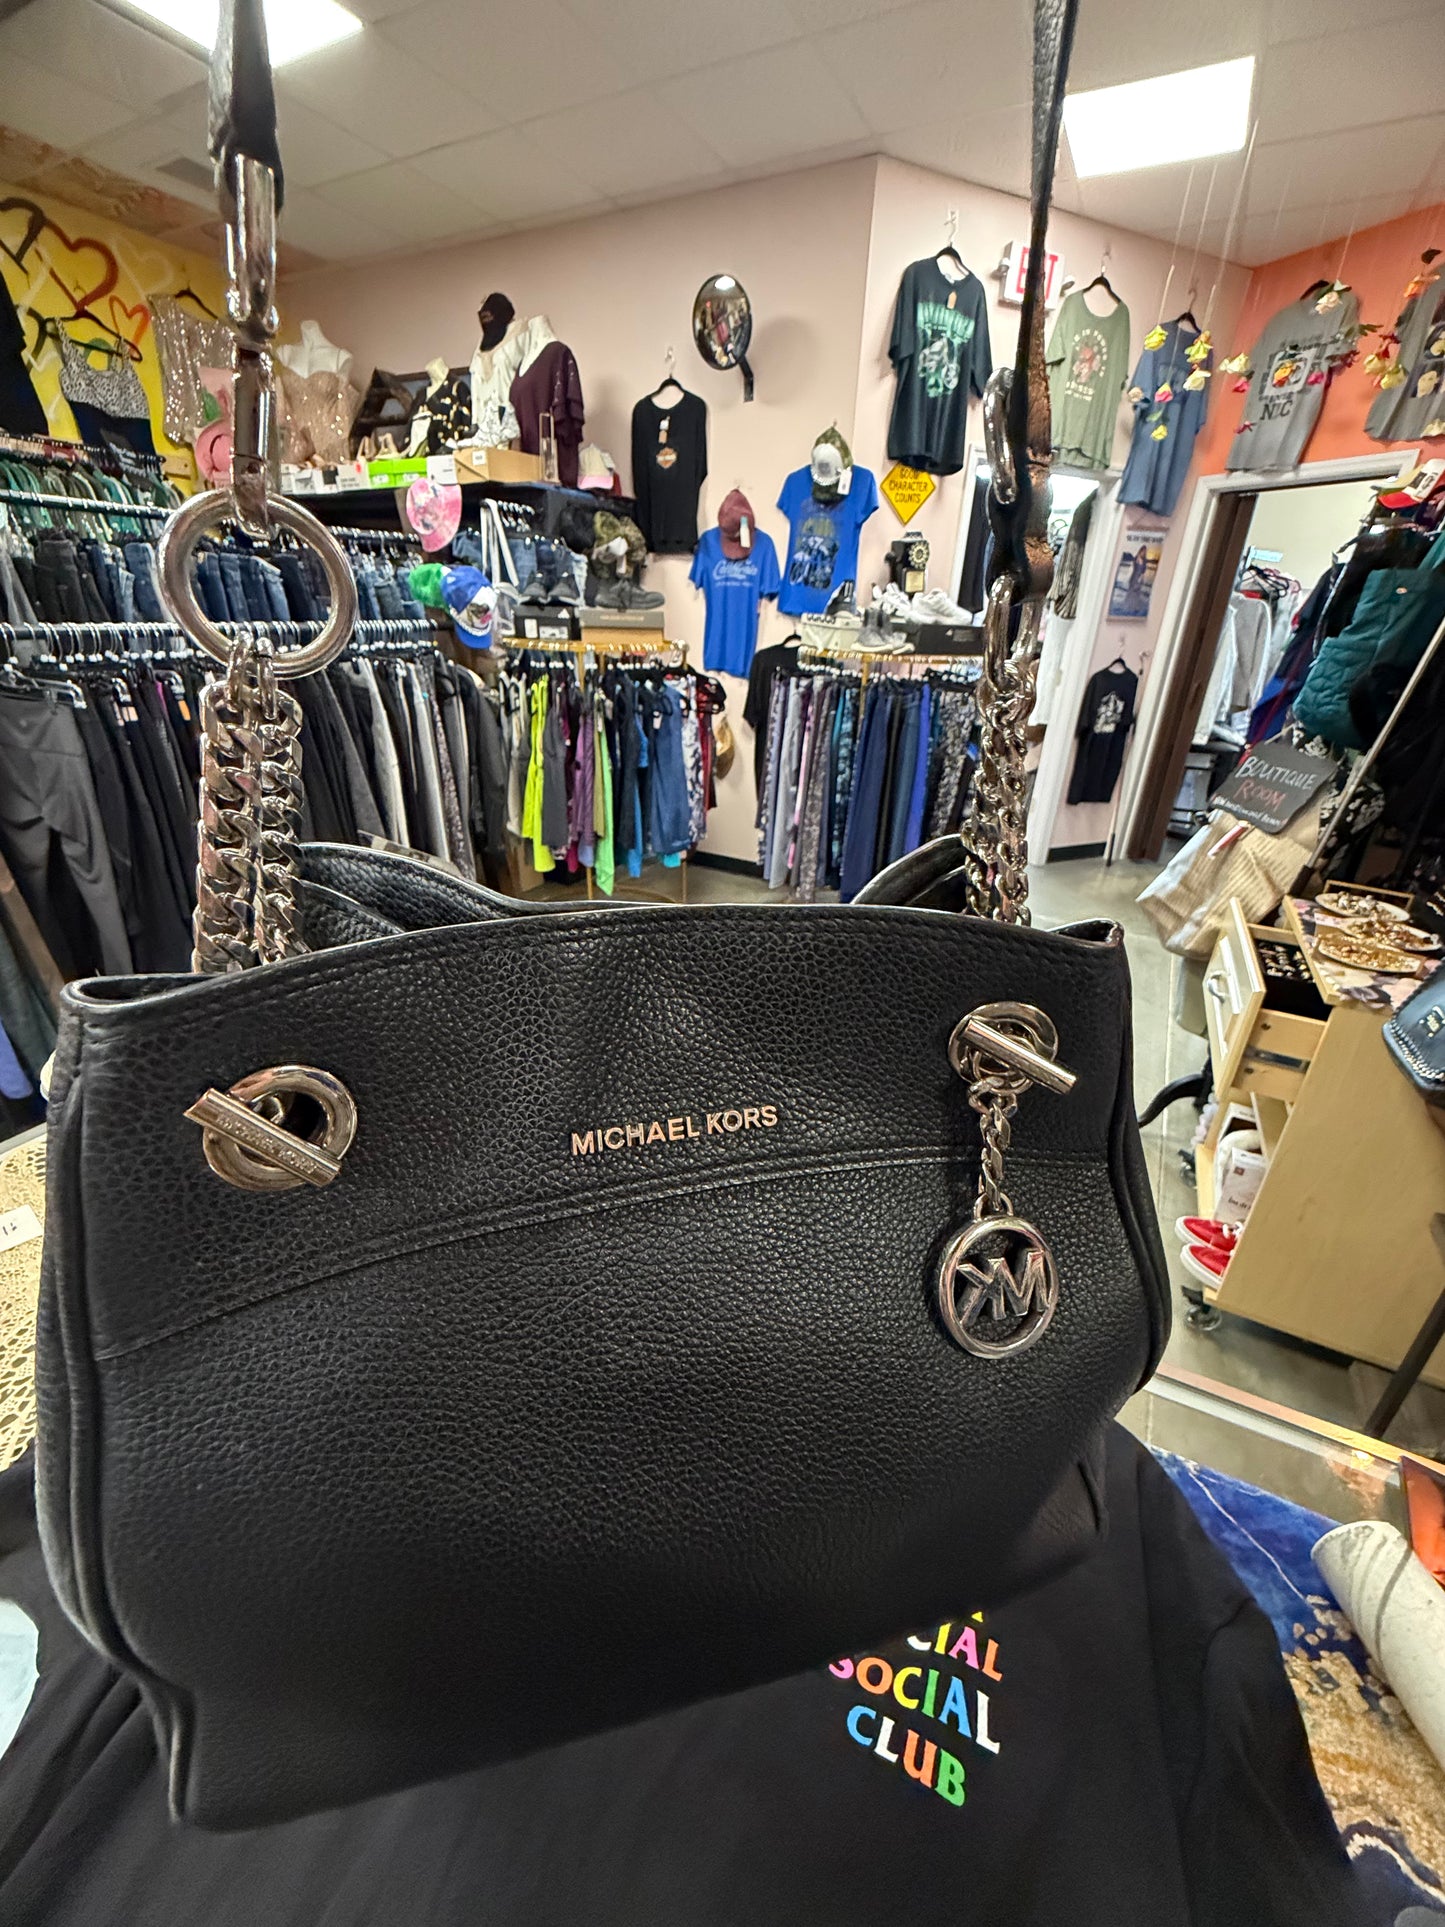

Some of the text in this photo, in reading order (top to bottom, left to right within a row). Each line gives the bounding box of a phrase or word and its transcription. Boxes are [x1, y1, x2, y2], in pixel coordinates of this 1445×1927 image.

[1016, 246, 1058, 300] ET
[888, 480, 928, 492] CHARACTER
[894, 492, 921, 503] COUNTS
[1235, 756, 1317, 790] BOUTIQUE
[1233, 780, 1287, 812] ROOM
[571, 1105, 778, 1156] MICHAEL KORS
[846, 1704, 968, 1807] CLUB
